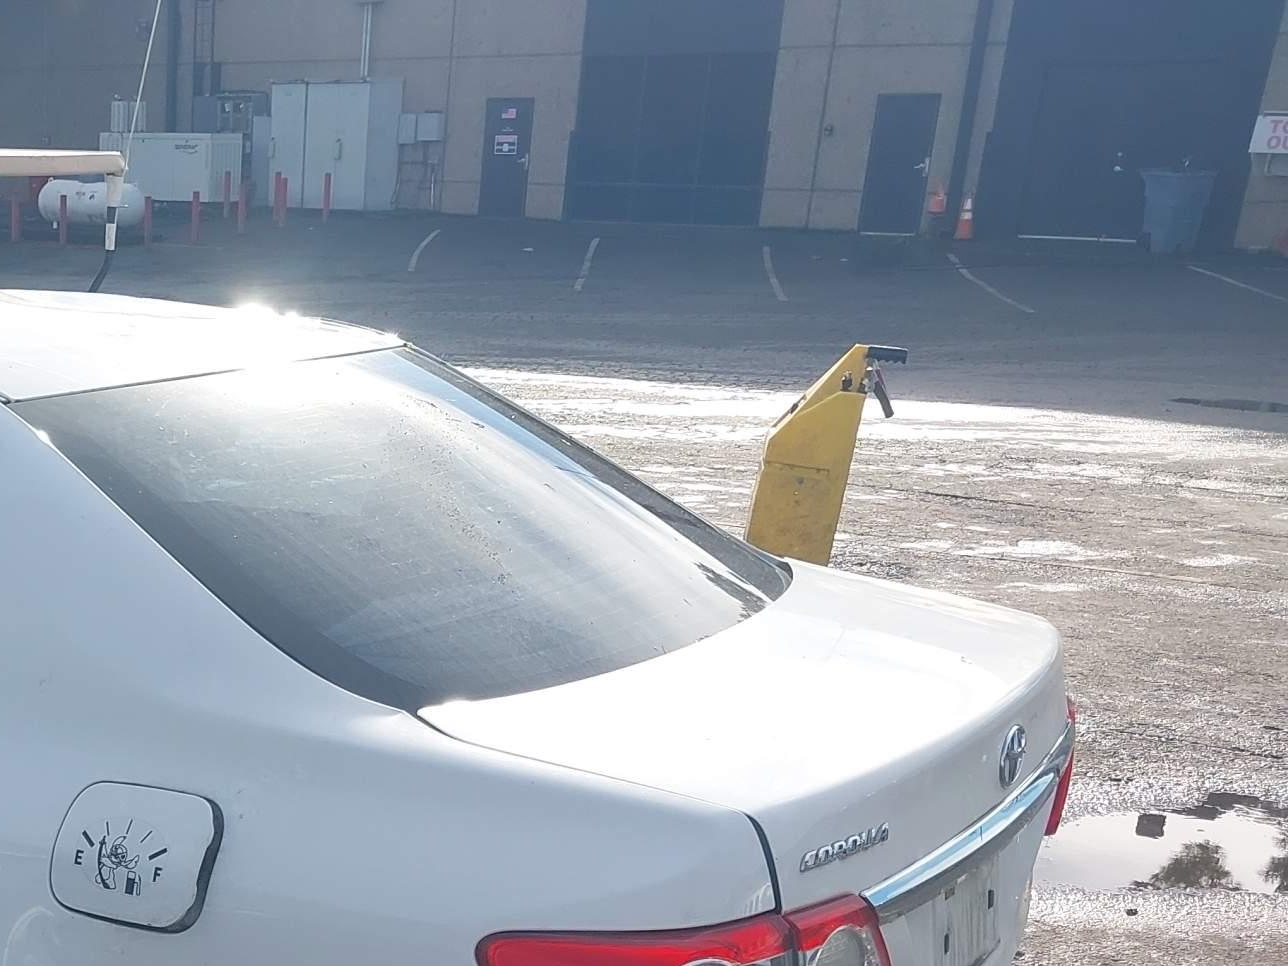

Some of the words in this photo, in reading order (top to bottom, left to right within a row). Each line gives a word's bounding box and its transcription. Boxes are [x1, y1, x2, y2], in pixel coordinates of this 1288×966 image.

[800, 822, 888, 872] COROLLA
[74, 849, 84, 865] E
[153, 867, 163, 882] F
